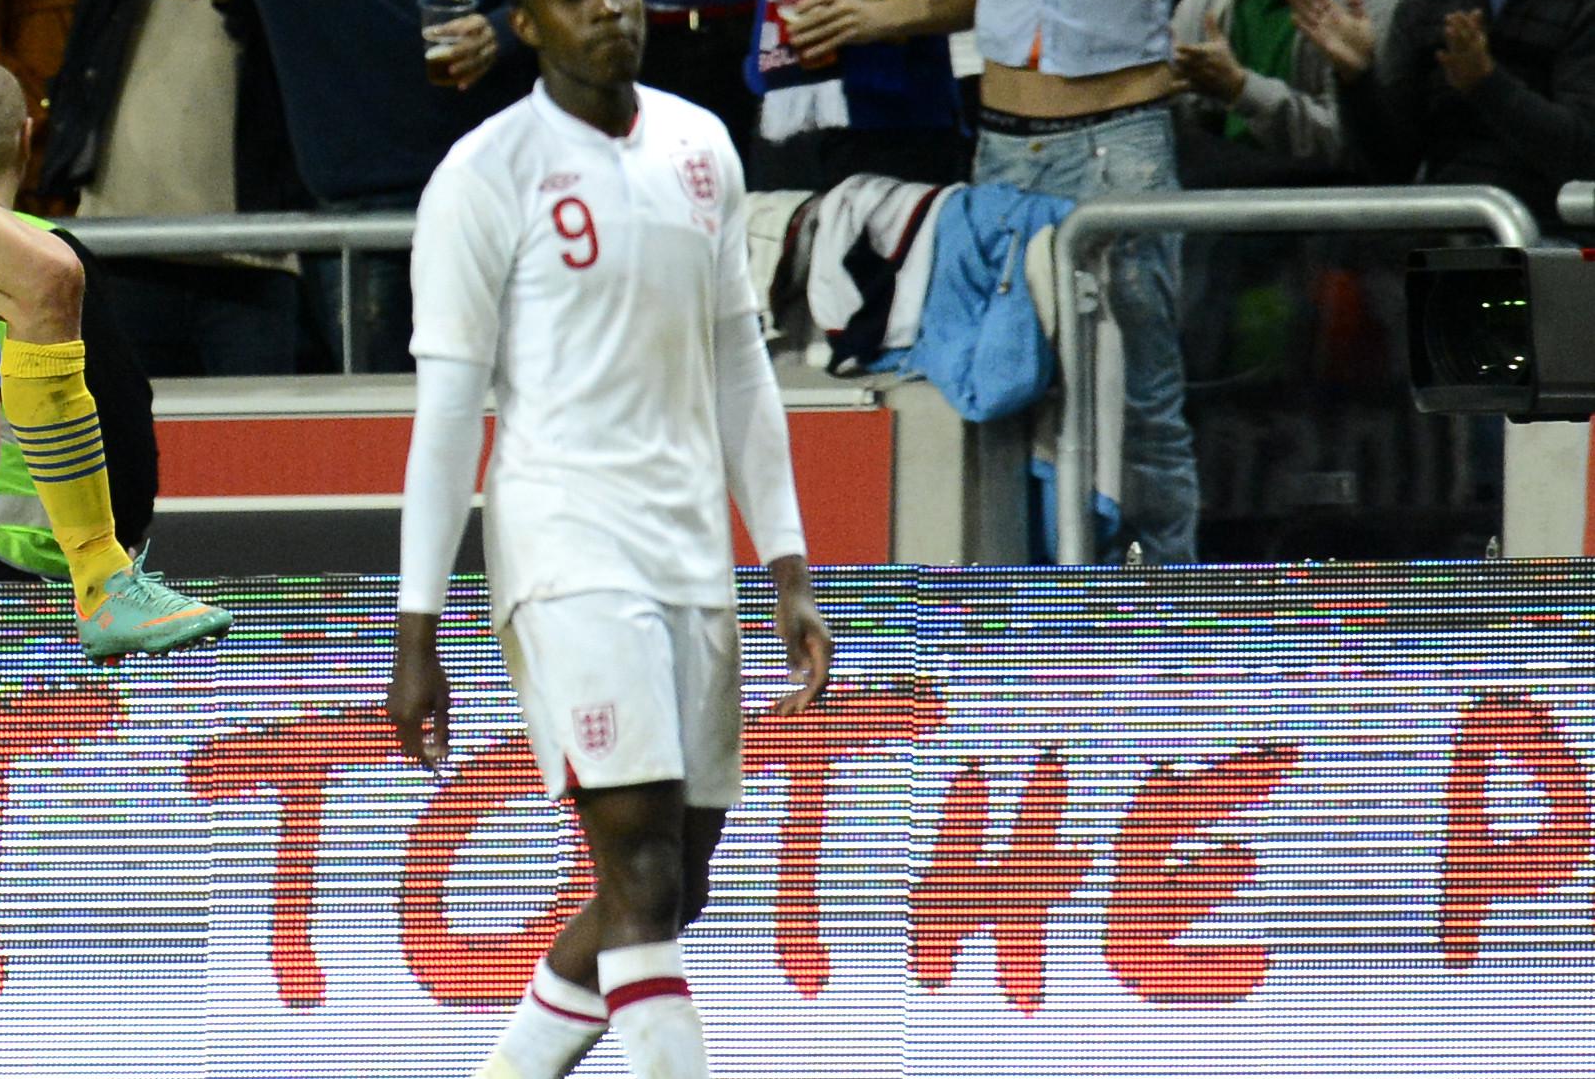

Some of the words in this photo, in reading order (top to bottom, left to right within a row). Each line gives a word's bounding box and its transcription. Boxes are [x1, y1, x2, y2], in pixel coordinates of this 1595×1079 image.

[552, 196, 599, 270] 9
[185, 704, 597, 1013] TO
[742, 676, 1300, 1018] THE
